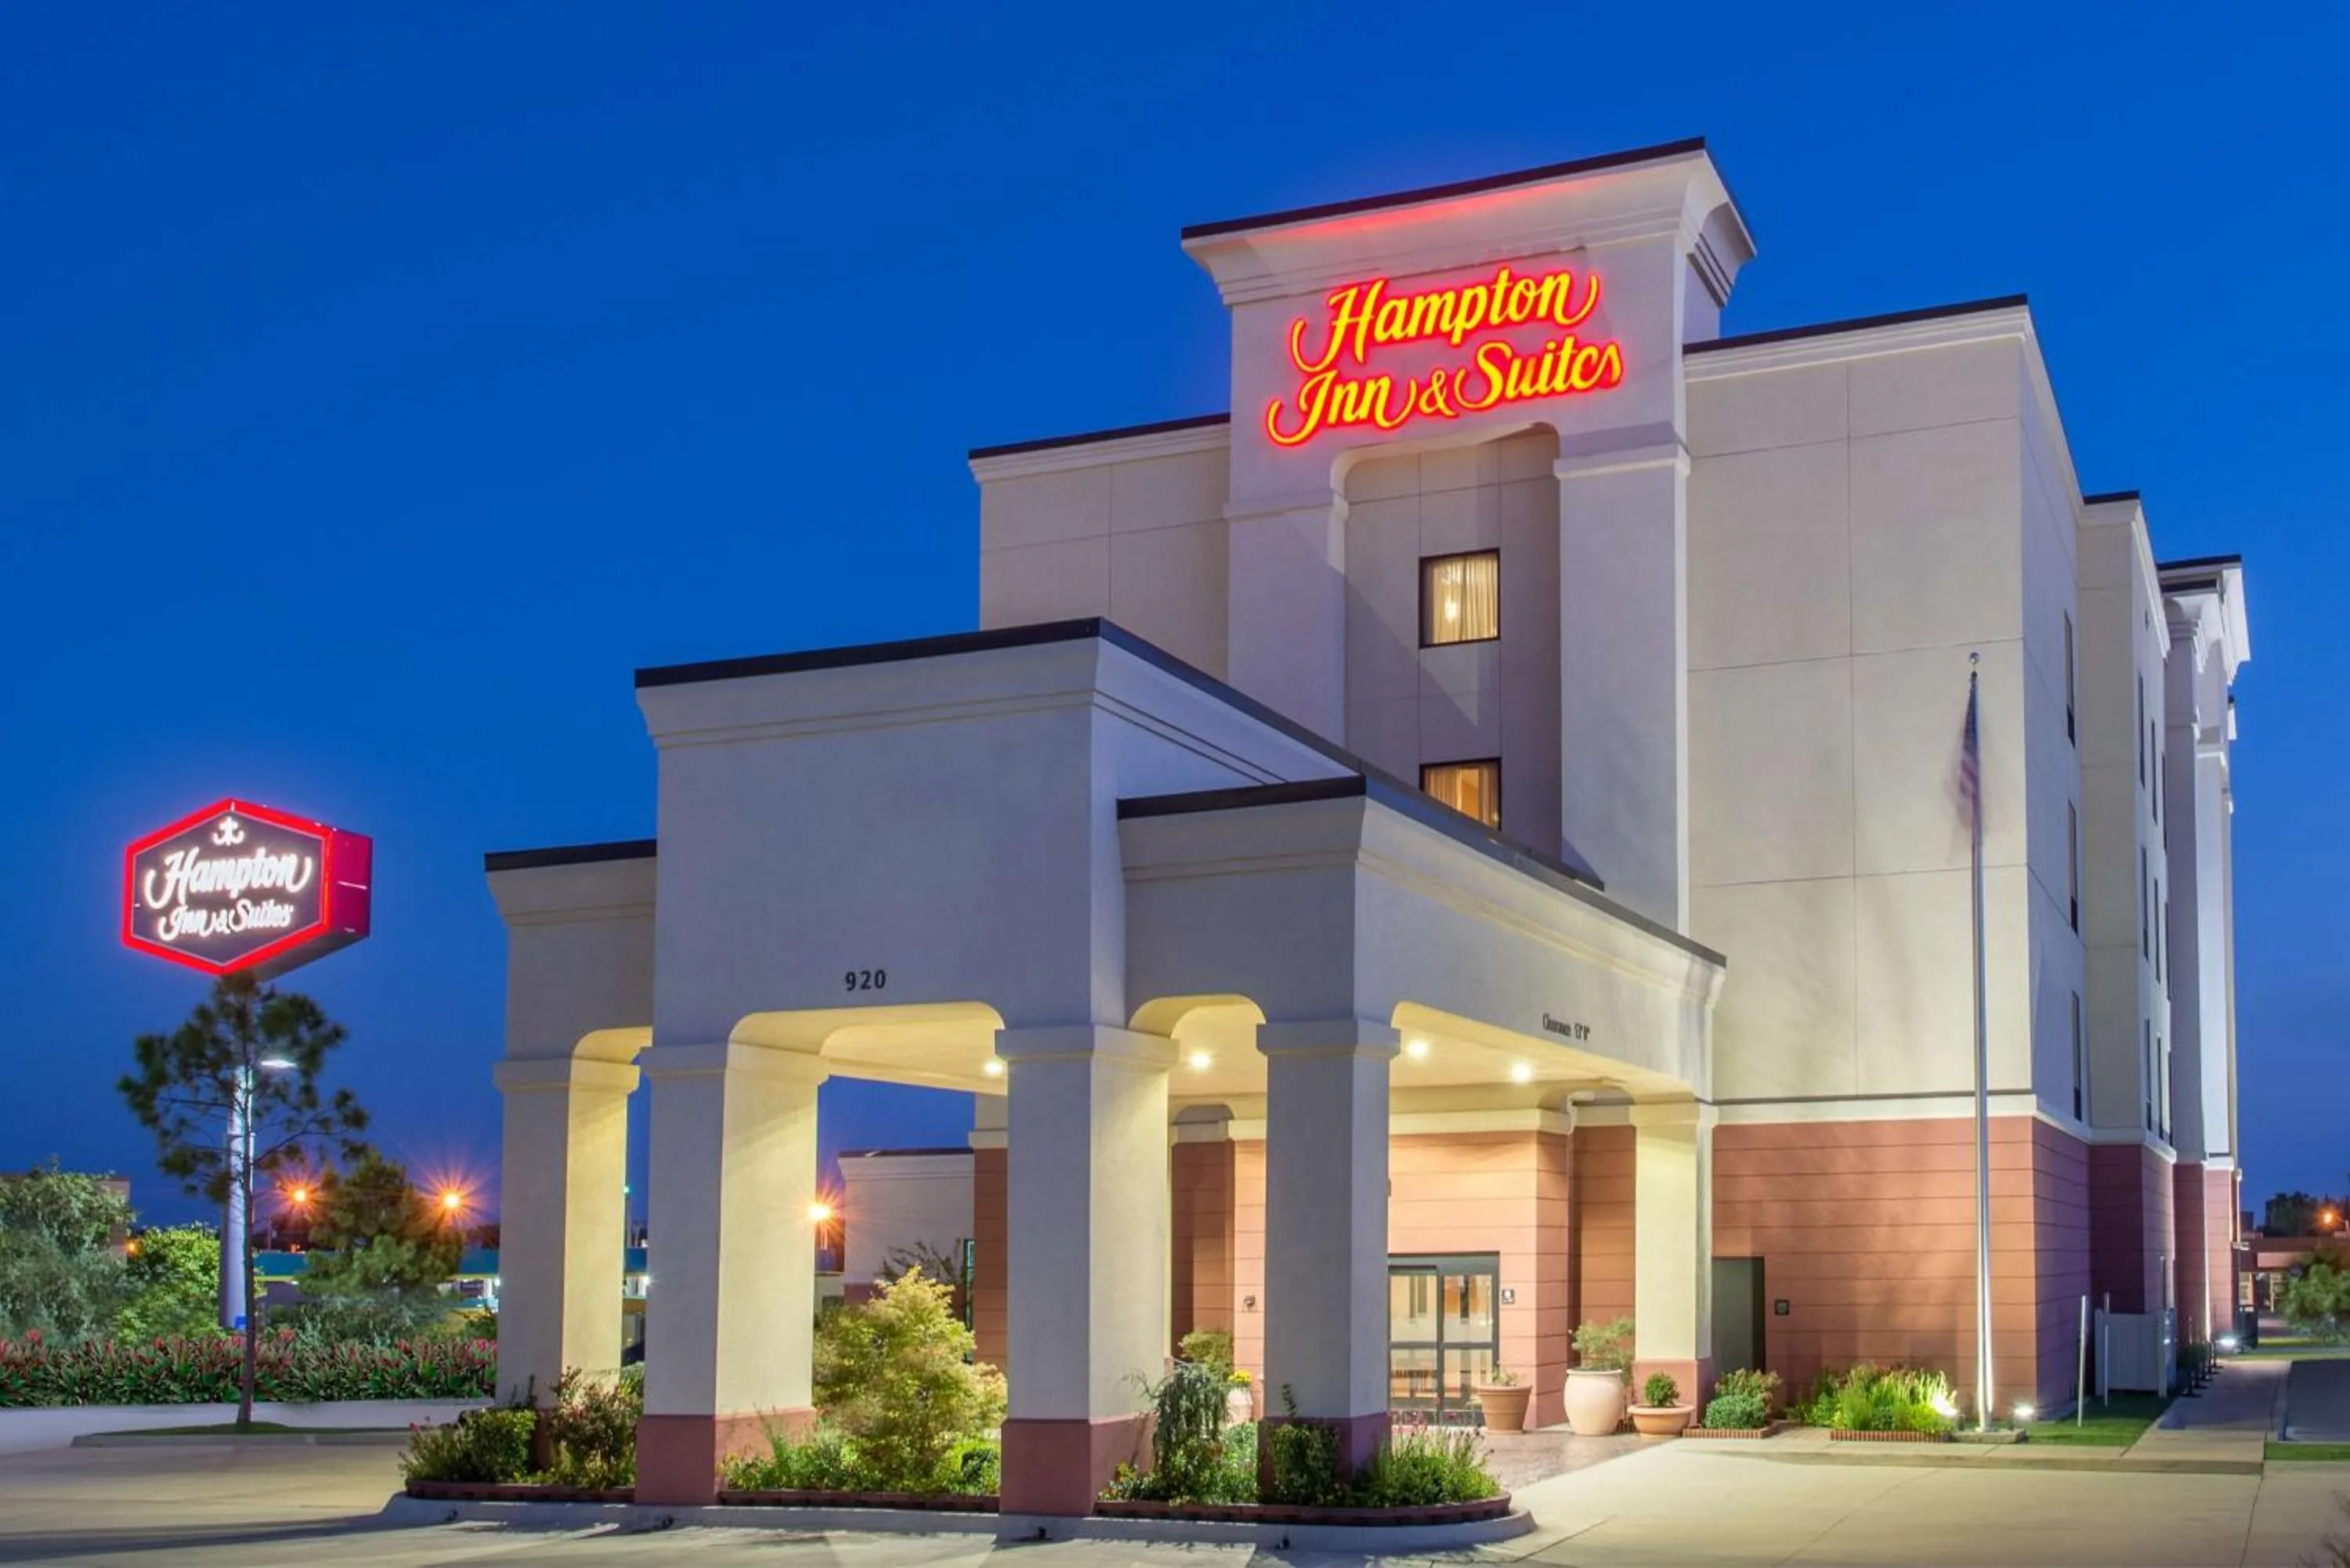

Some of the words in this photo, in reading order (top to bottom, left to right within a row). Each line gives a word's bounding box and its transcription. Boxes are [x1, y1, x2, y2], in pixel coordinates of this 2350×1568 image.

[1291, 266, 1599, 374] Hampton
[1267, 370, 1416, 446] Inn
[1419, 369, 1457, 417] &
[1454, 335, 1624, 410] Suites
[145, 847, 312, 909] Hampton
[159, 905, 214, 941] Inn
[215, 908, 230, 934] &
[229, 899, 294, 930] Suites
[844, 969, 886, 992] 920
